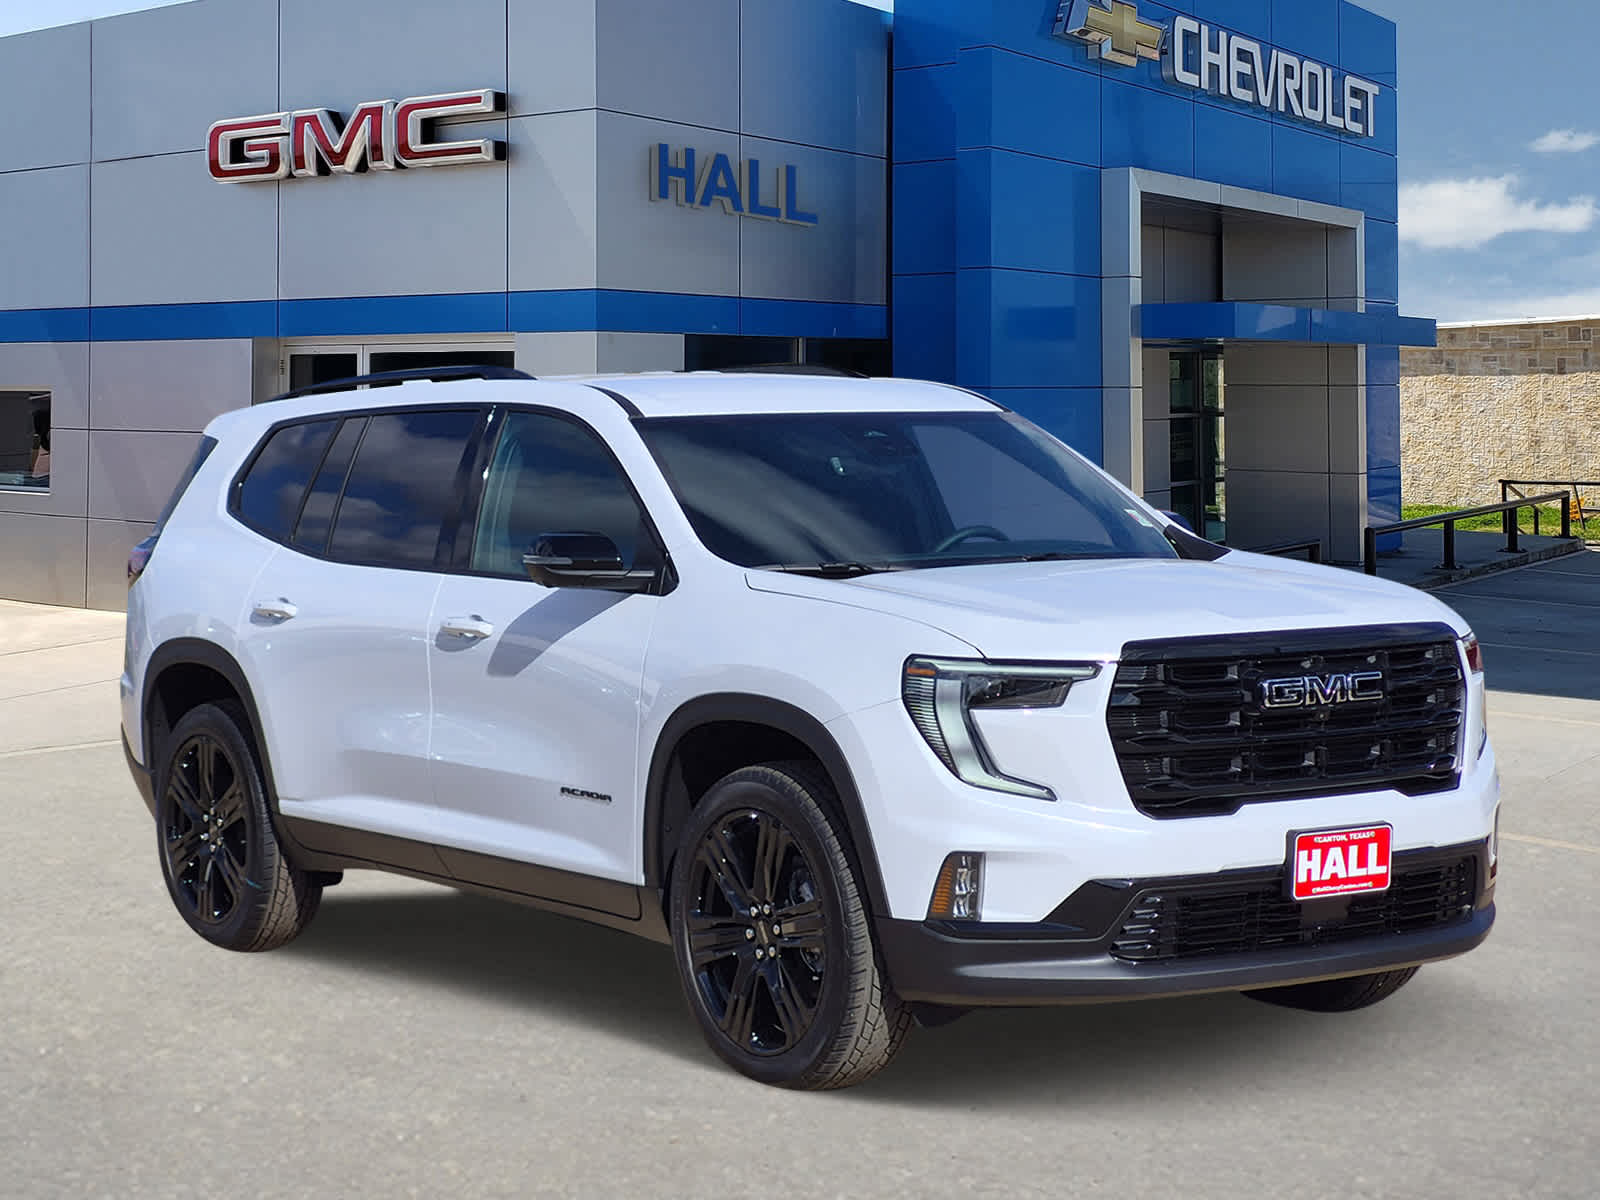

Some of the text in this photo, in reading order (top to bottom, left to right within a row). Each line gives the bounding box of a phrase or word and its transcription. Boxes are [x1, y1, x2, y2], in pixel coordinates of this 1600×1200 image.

[1172, 15, 1380, 138] CHEVROLET
[208, 88, 507, 184] GMC
[653, 142, 818, 226] HALL
[1262, 671, 1383, 708] GMC
[560, 786, 613, 802] ACADIA
[1297, 842, 1388, 883] HALL
